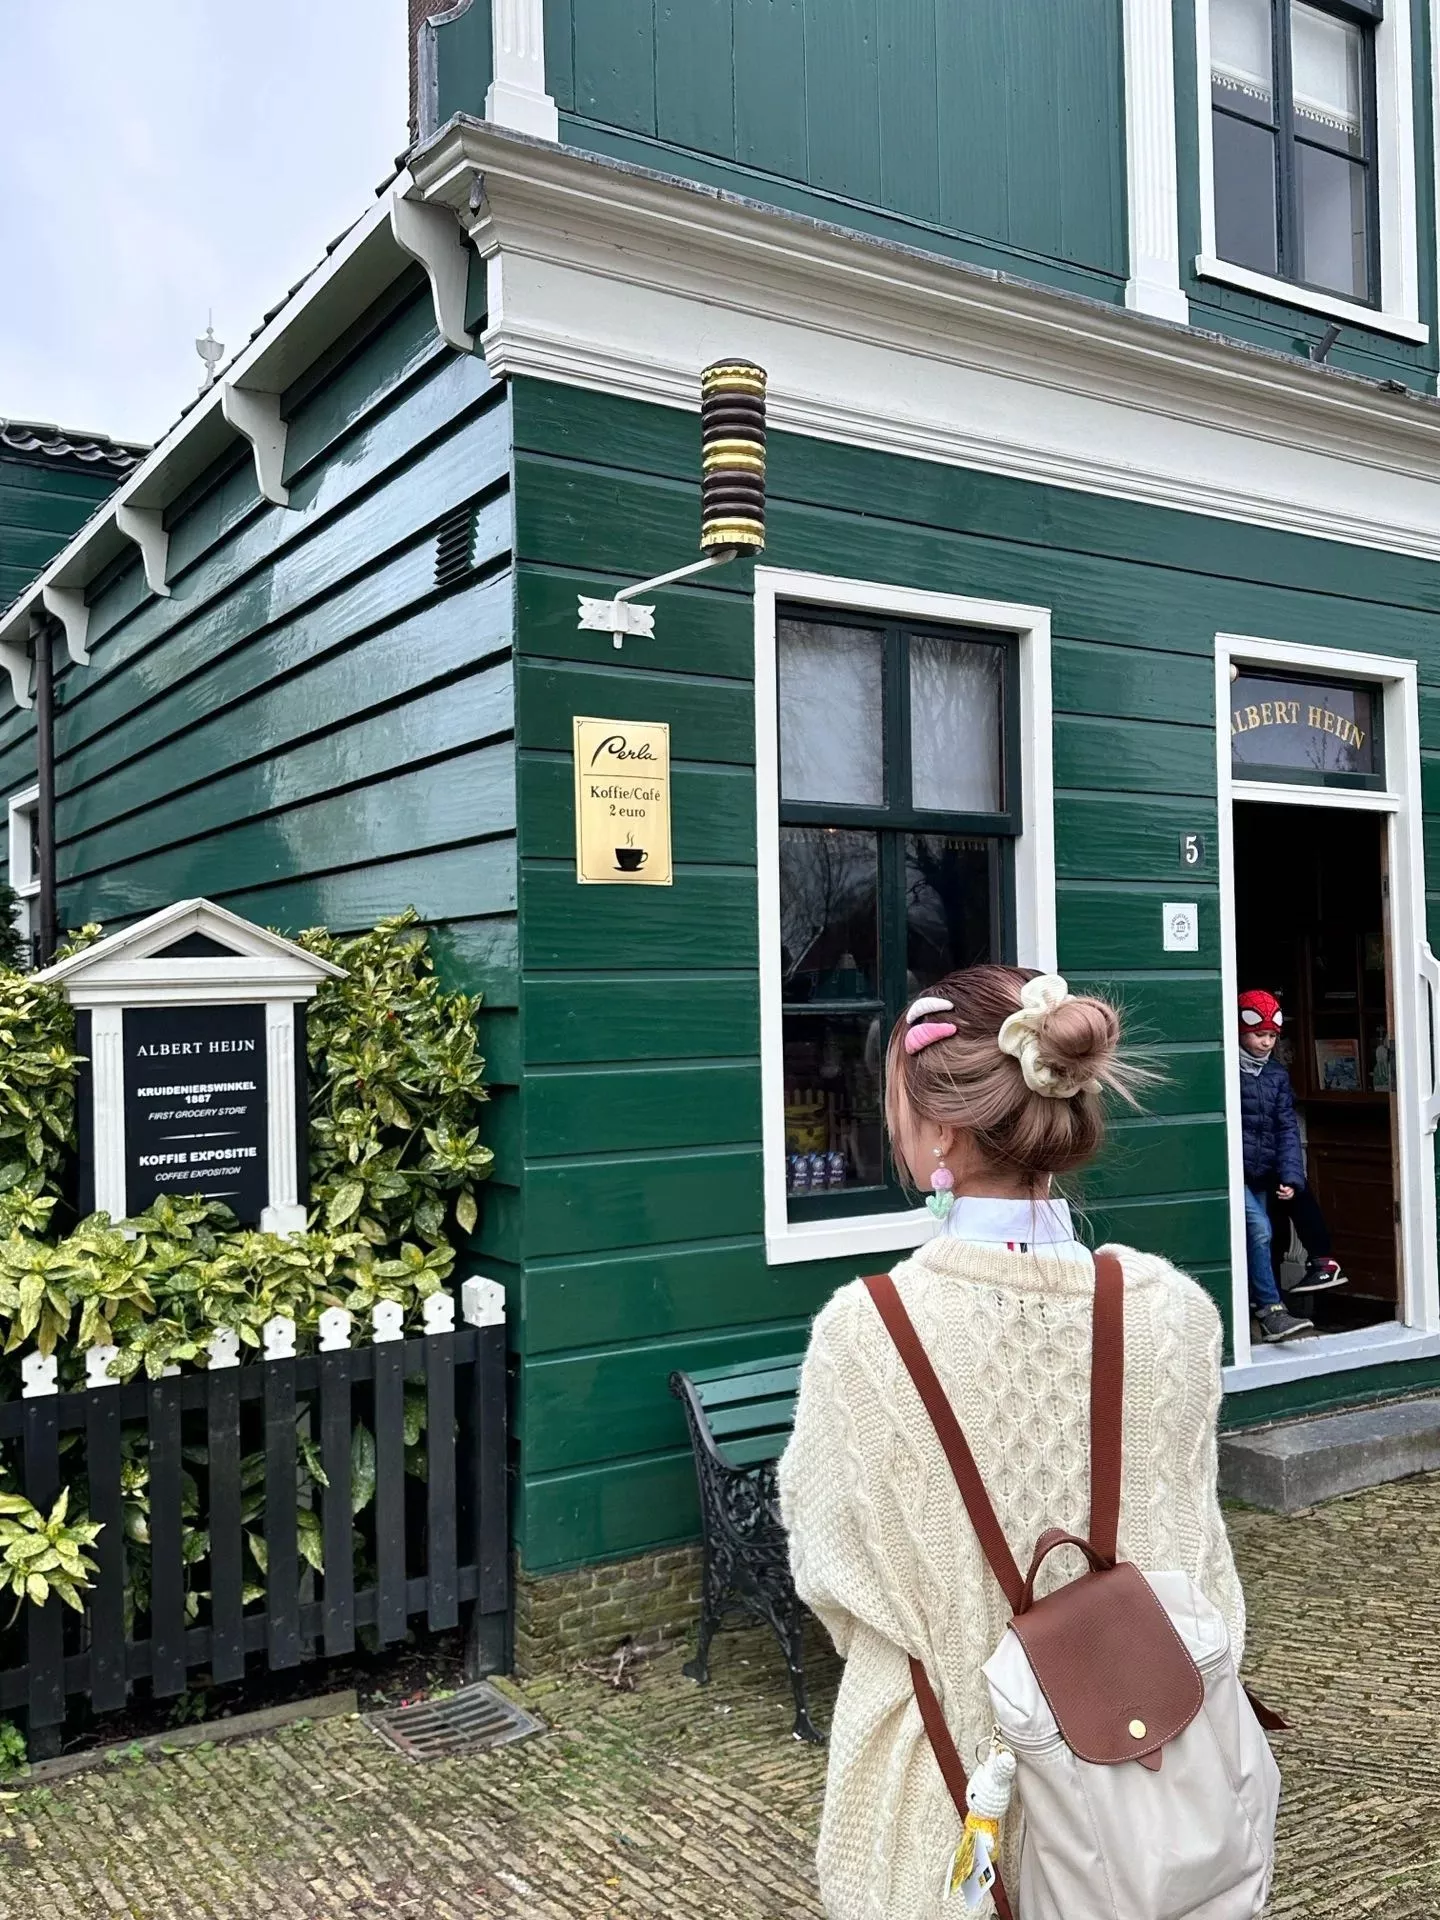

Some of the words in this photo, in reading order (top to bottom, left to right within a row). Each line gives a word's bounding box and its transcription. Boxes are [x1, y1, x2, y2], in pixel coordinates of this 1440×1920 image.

[1308, 705, 1365, 750] HEIJN
[590, 735, 658, 768] Perla
[590, 785, 661, 801] Koffie/Café
[609, 804, 616, 817] 2
[619, 808, 646, 818] euro
[1186, 835, 1198, 863] 5
[136, 1042, 203, 1057] ALBERT
[209, 1039, 255, 1054] HEIJN
[137, 1081, 256, 1097] KRUIDENIERSWINKEL
[185, 1094, 211, 1104] 1887
[148, 1111, 174, 1121] FIRST
[175, 1108, 218, 1119] GROCERY
[218, 1106, 247, 1116] STORE
[139, 1152, 187, 1167] KOFFIE
[190, 1147, 257, 1162] EXPOSITIE
[155, 1169, 189, 1182] COFFEE
[190, 1166, 241, 1179] EXPOSITION
